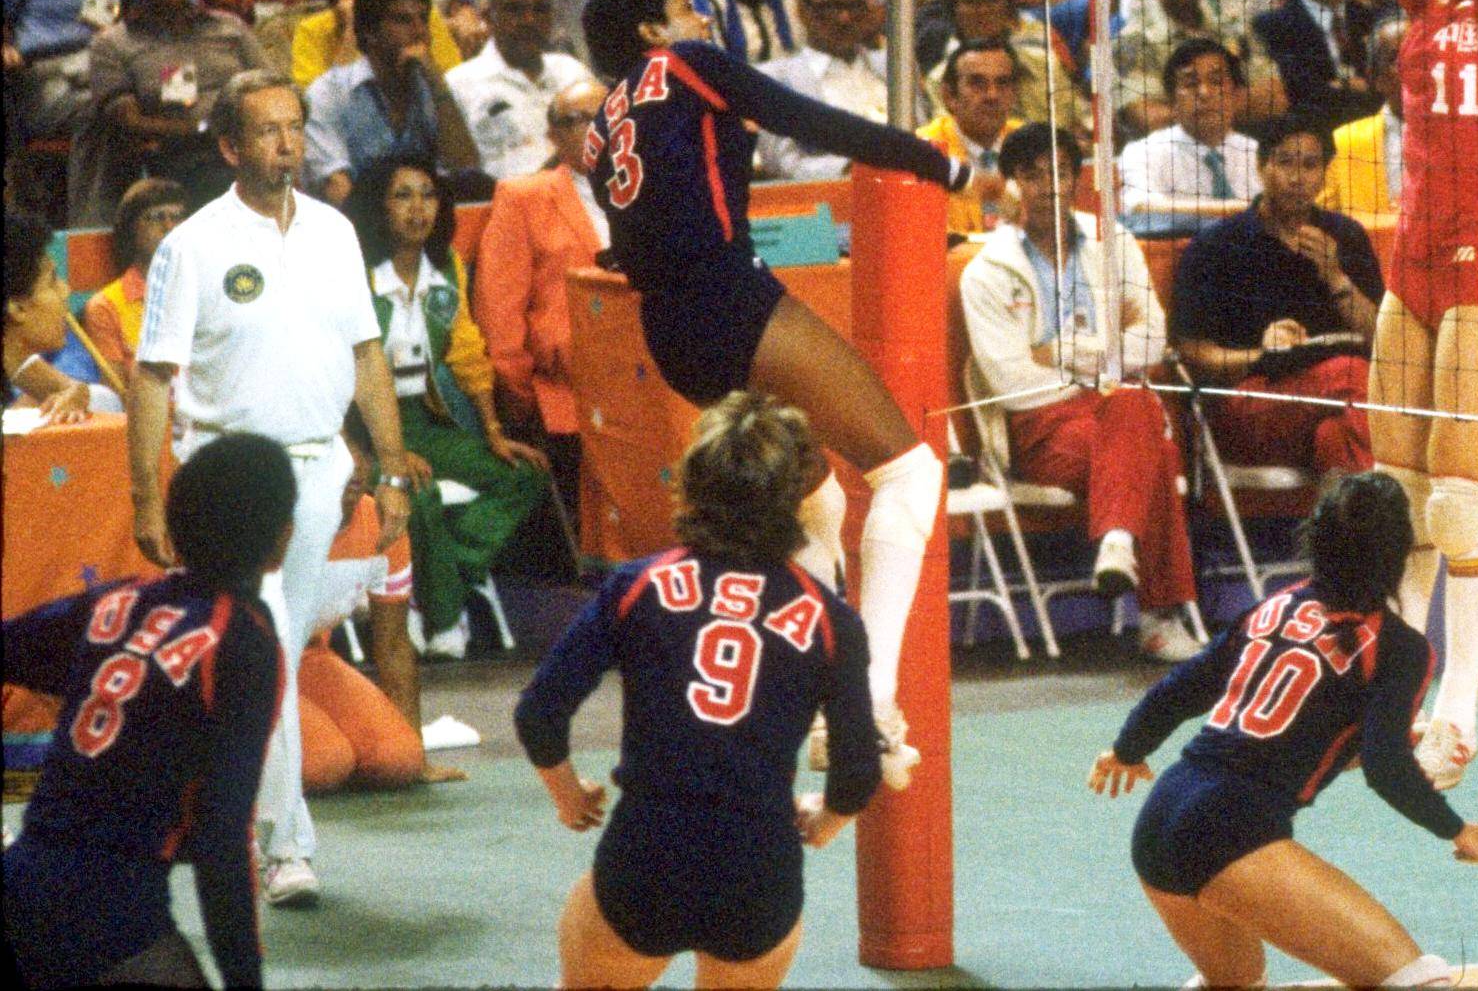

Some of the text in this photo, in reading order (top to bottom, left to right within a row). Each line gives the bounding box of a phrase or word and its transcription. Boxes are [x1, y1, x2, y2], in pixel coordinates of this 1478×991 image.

[582, 56, 670, 173] USA
[606, 118, 644, 209] 3
[86, 589, 219, 688] USA
[649, 559, 824, 653] USA
[1247, 593, 1377, 675] USA
[70, 651, 149, 759] 8
[686, 619, 764, 726] 9
[1207, 638, 1323, 739] 10
